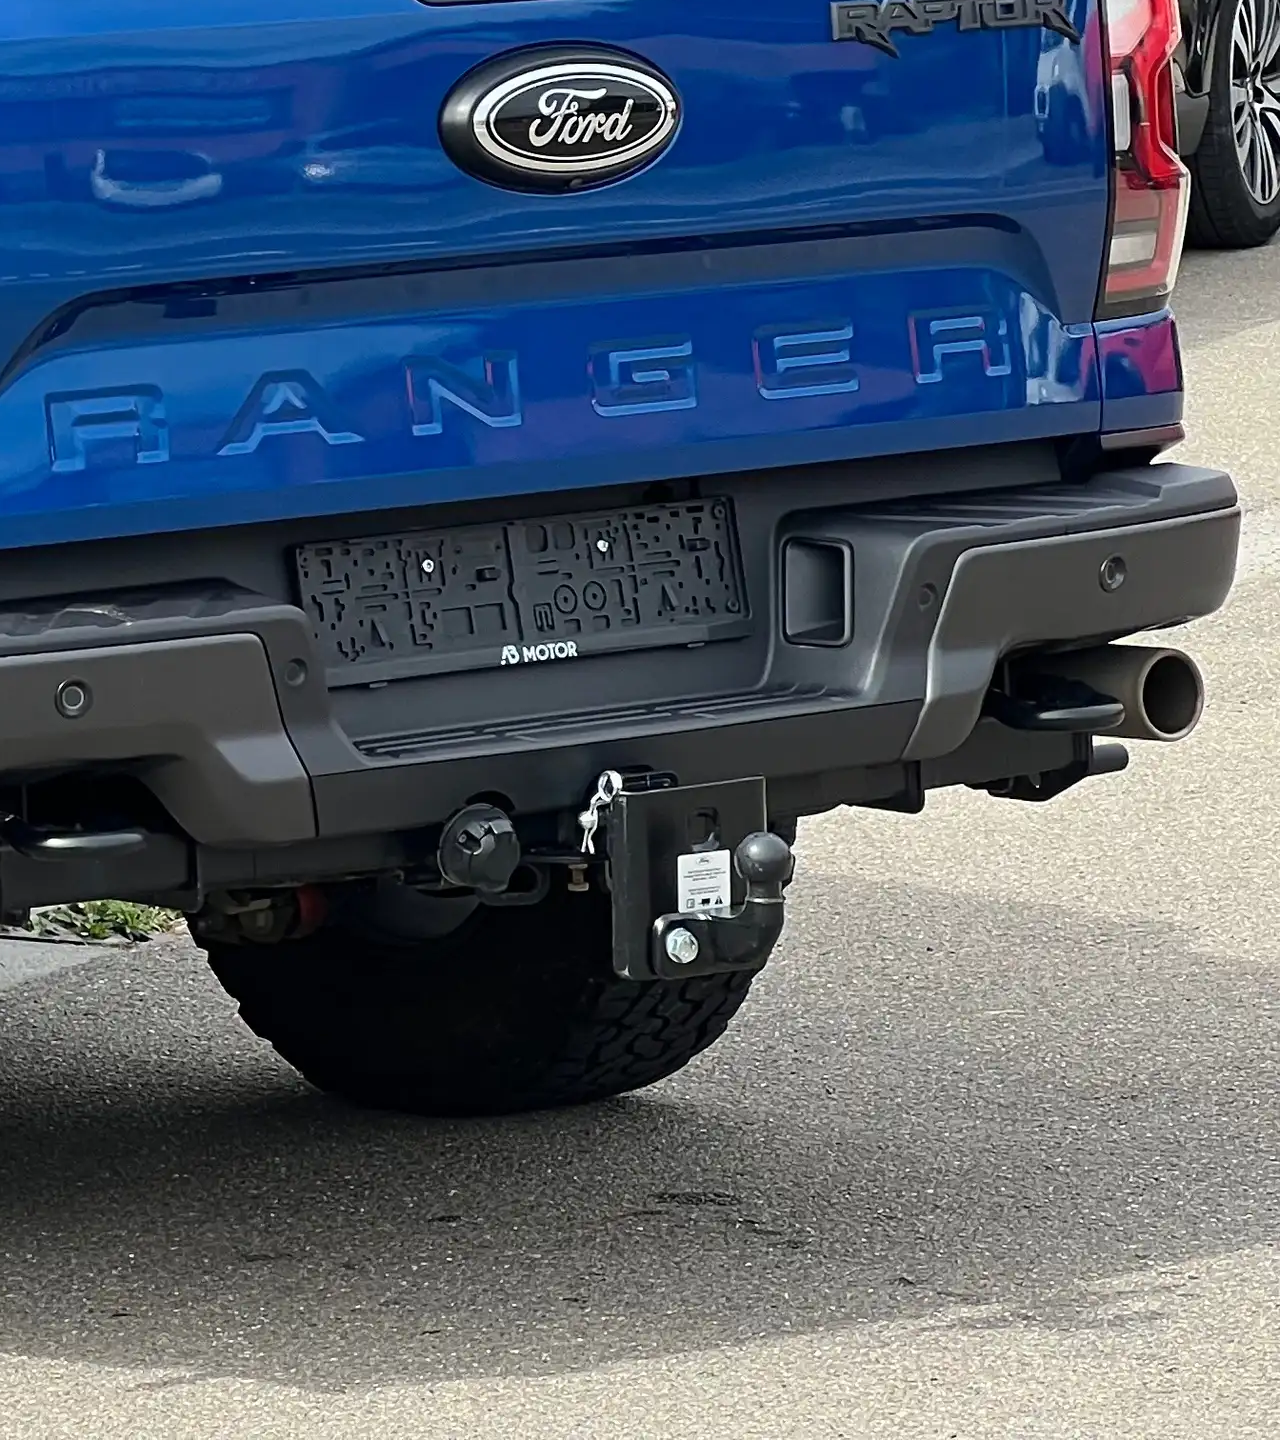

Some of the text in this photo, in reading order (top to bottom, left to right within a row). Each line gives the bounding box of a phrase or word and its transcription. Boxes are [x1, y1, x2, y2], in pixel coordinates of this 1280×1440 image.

[528, 88, 634, 147] Ford
[45, 310, 1013, 472] RANGER
[522, 641, 578, 663] MOTOR
